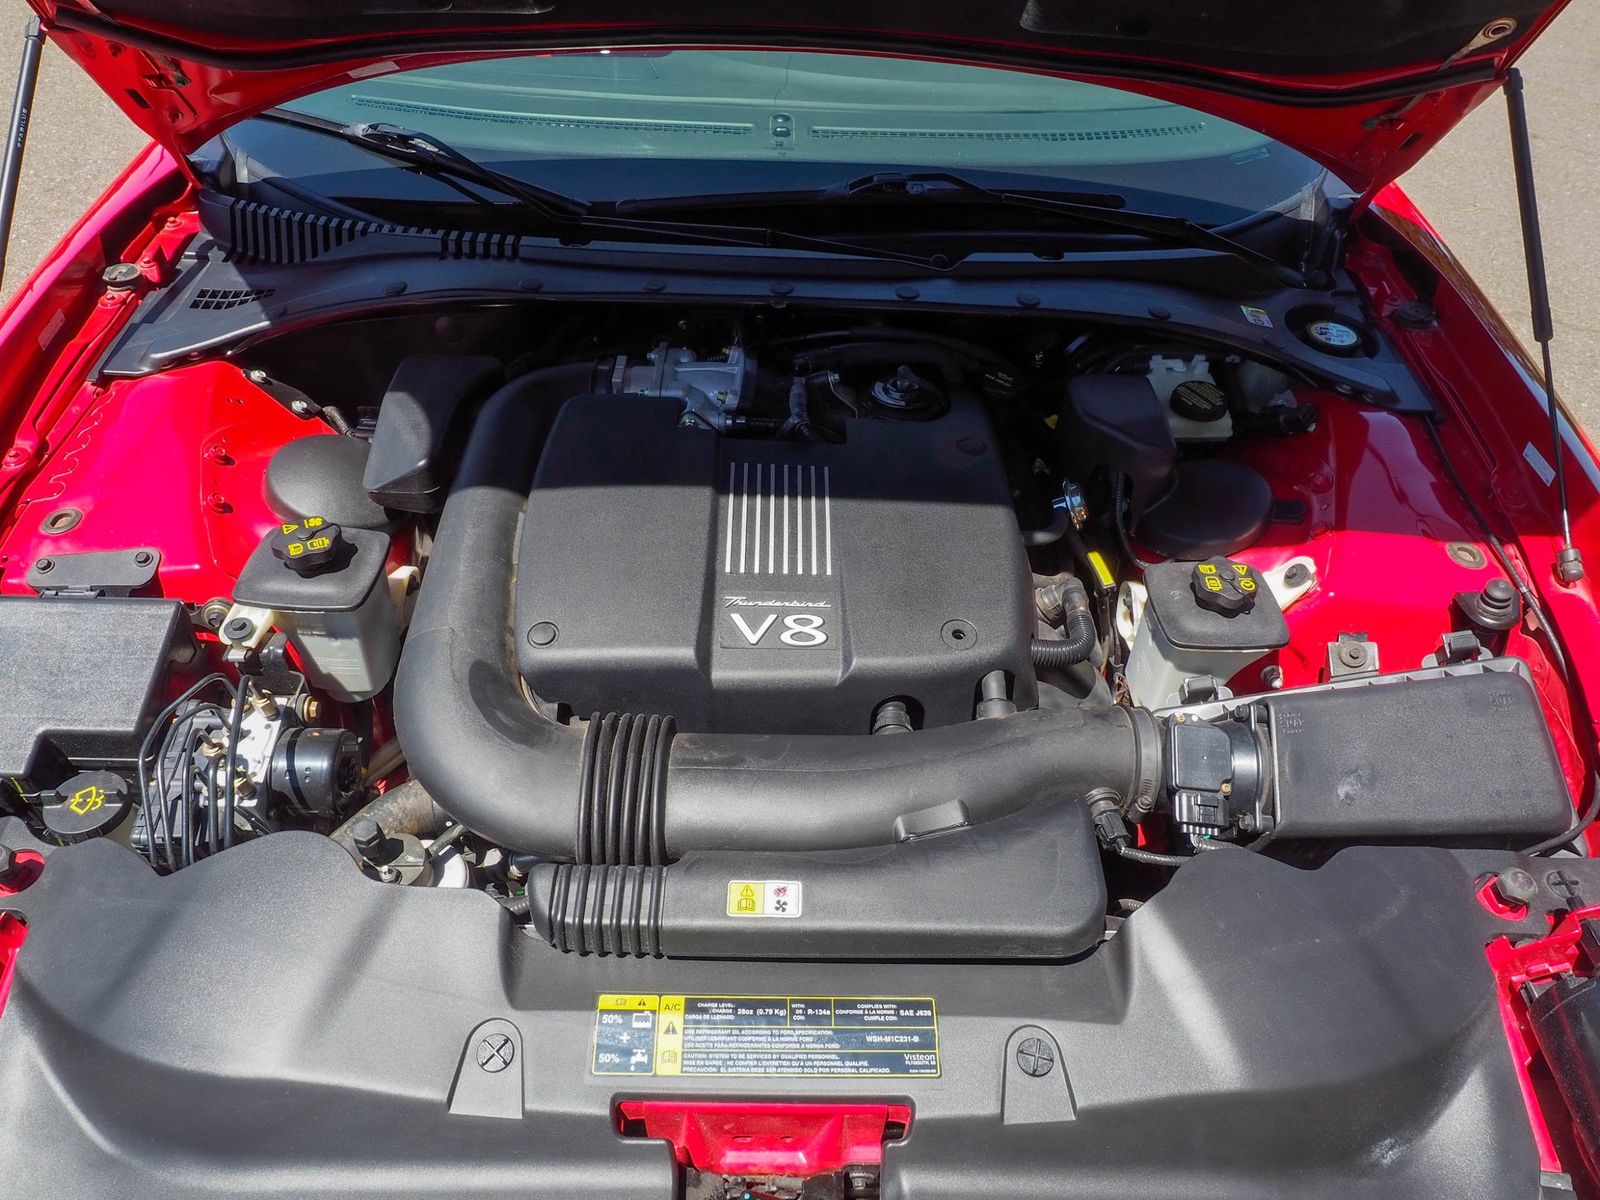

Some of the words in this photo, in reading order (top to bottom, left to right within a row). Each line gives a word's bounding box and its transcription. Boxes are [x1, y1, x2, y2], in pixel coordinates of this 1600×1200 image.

[724, 596, 832, 608] Thunderbird
[730, 613, 829, 647] V8
[602, 1014, 622, 1024] 50%
[598, 1054, 620, 1063] 50%
